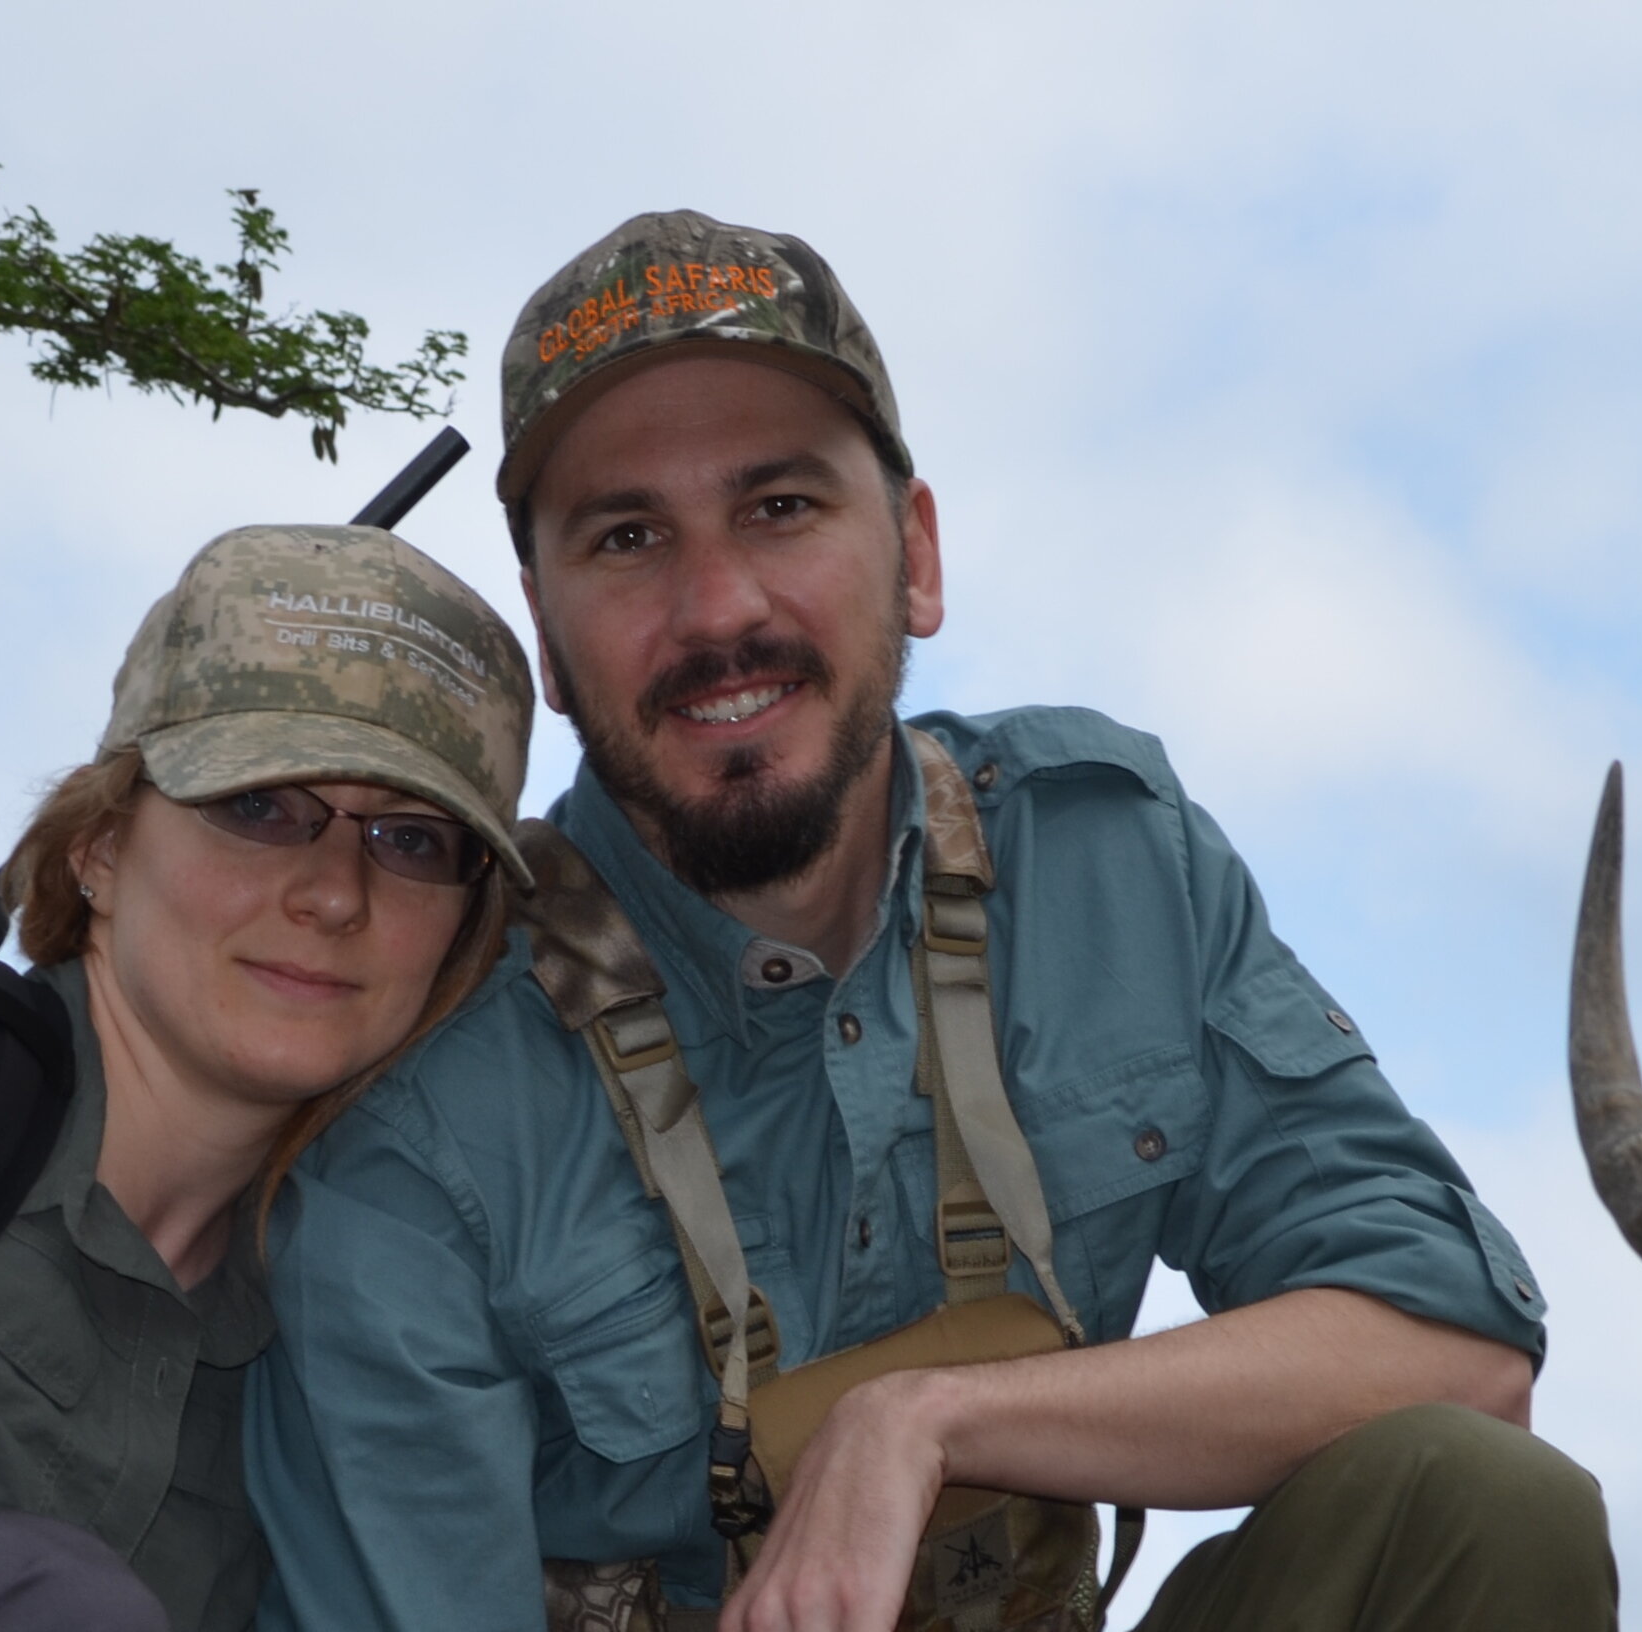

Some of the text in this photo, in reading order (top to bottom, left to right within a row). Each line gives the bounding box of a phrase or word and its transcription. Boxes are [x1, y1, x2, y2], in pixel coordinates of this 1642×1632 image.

[538, 262, 776, 364] GLOBAL SAFARIS
[574, 290, 739, 362] SOUTH AFRICA
[268, 590, 487, 679] HALLIBURTON
[276, 628, 476, 708] Drill Bits & Services
